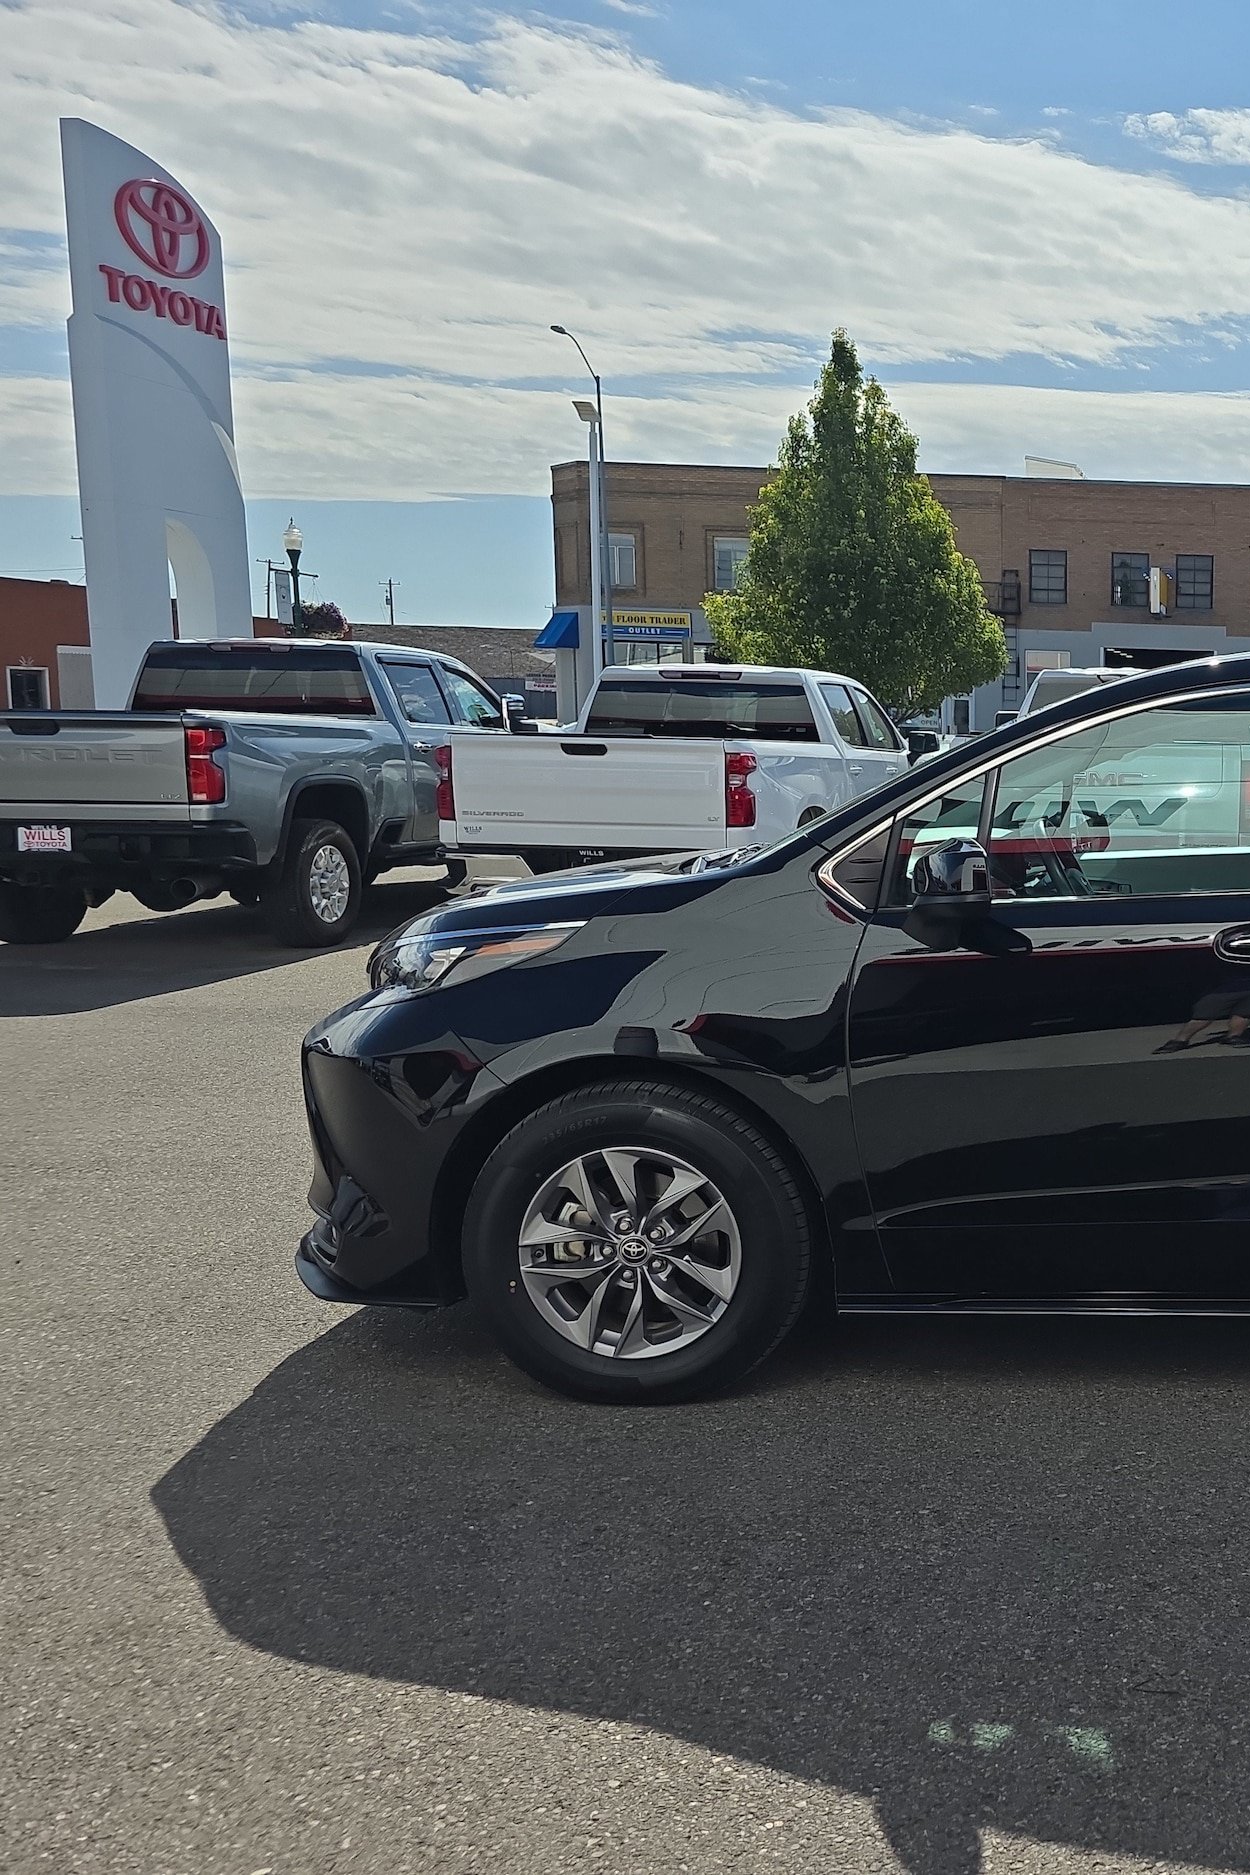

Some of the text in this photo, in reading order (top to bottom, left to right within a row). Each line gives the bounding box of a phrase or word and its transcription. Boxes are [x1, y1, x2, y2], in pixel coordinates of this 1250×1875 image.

[99, 264, 227, 341] TOYOTA
[616, 615, 647, 624] FLOOR
[649, 616, 686, 625] TRADER
[628, 627, 661, 635] OUTLET
[23, 830, 66, 841] WILLS
